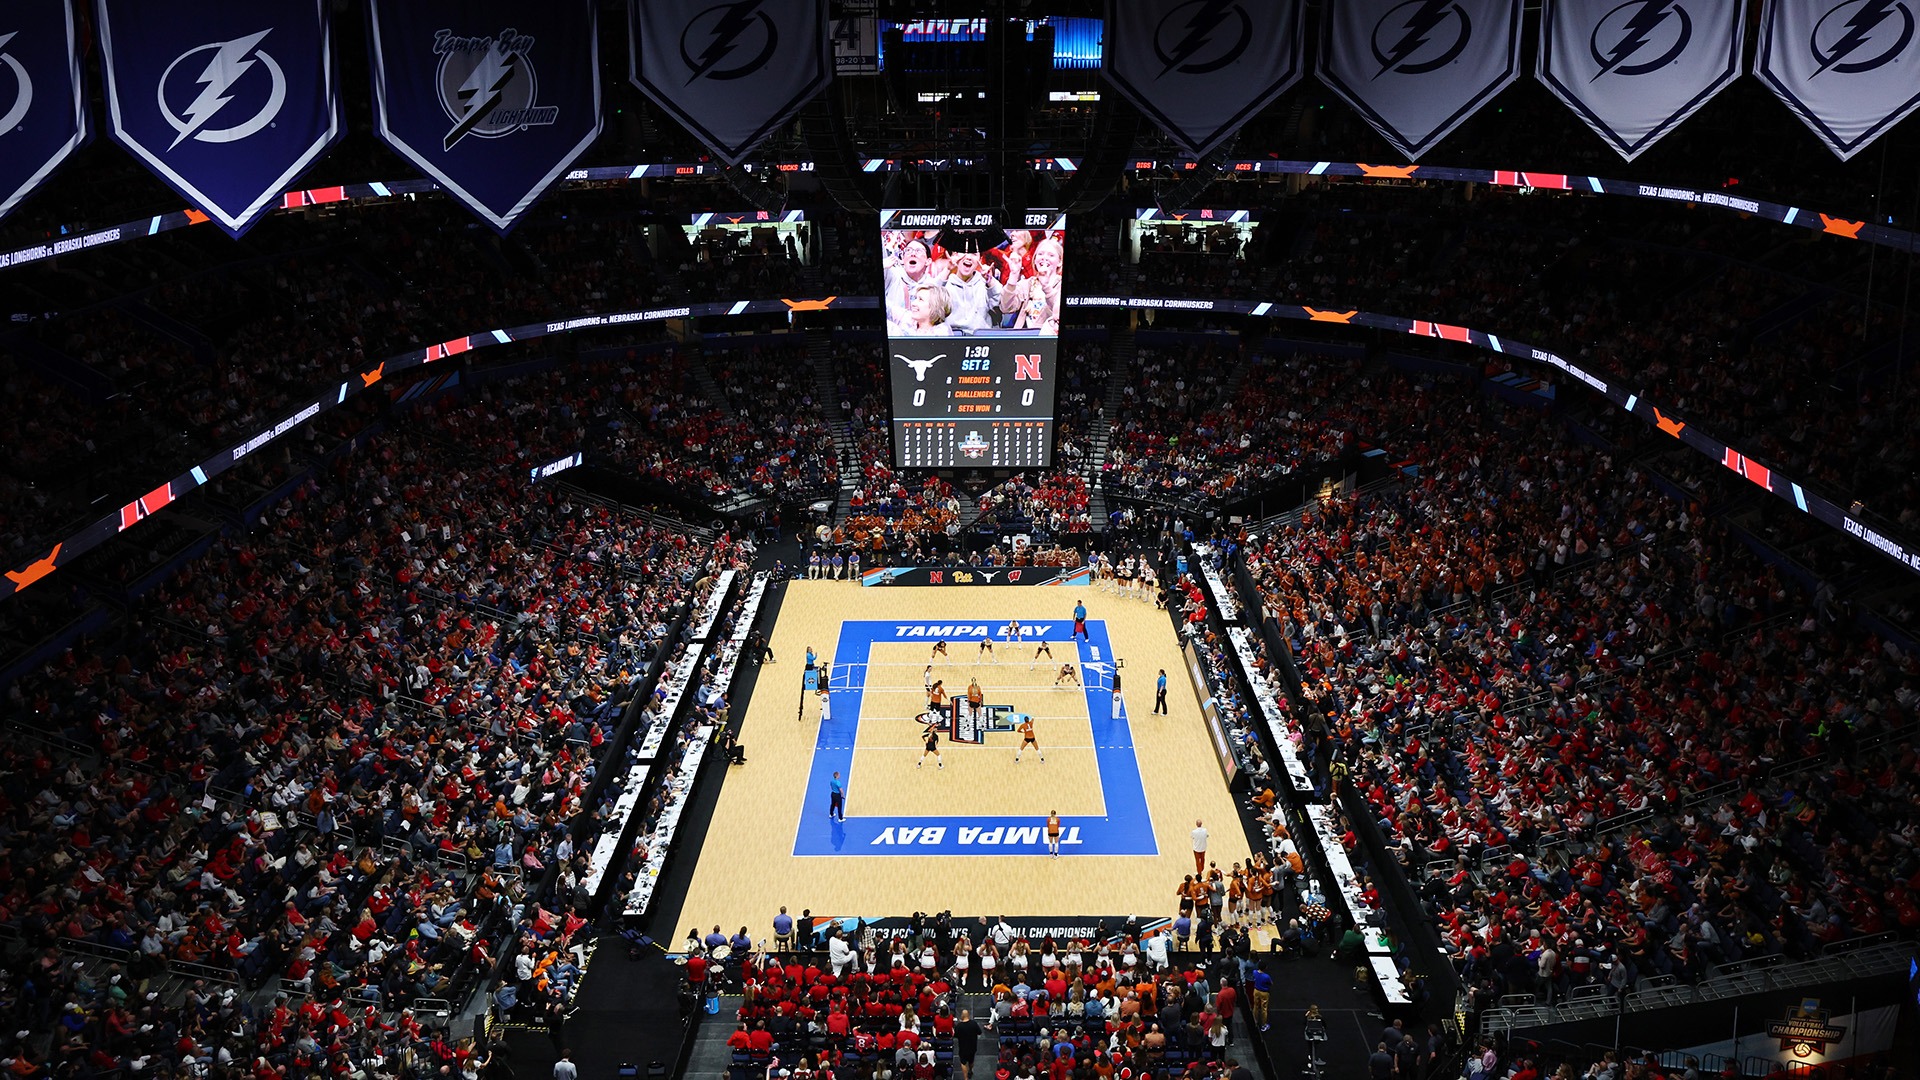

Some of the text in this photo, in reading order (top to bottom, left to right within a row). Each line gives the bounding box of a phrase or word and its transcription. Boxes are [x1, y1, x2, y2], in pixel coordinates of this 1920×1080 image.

[433, 28, 535, 56] Tampa Bay
[489, 109, 556, 125] LIGHTNING
[801, 163, 814, 172] 3.0
[1254, 162, 1261, 171] 2
[1638, 185, 1657, 197] TEXAS
[1658, 187, 1694, 201] LONGHORNS
[11, 245, 46, 265] LONGHORNS
[54, 236, 82, 254] NEBRASKA
[1080, 298, 1120, 306] LONGHORNS
[1128, 299, 1163, 308] NEBRASKA
[1164, 300, 1214, 310] CORNHUSKERS
[546, 322, 565, 333] TEXAS
[565, 316, 600, 329] LONGHORNS
[609, 312, 643, 324] NEBRASKA
[644, 308, 690, 320] CORNHUSKERS
[965, 346, 990, 358] 1:30
[962, 360, 990, 371] SET 2
[1014, 354, 1043, 380] N
[913, 389, 926, 406] 0
[1022, 389, 1034, 406] 0
[1844, 516, 1863, 538] TEXAS
[1863, 528, 1902, 560] LONGHORNS
[930, 571, 943, 583] N
[952, 571, 974, 583] Pitt
[1008, 570, 1022, 583] W
[895, 626, 1052, 636] TAMPA BAY
[870, 826, 947, 844] BAY
[1788, 1020, 1824, 1029] VOLLEYBALL
[1771, 1025, 1840, 1039] CHAMPIONSHIP
[858, 1038, 866, 1048] 8
